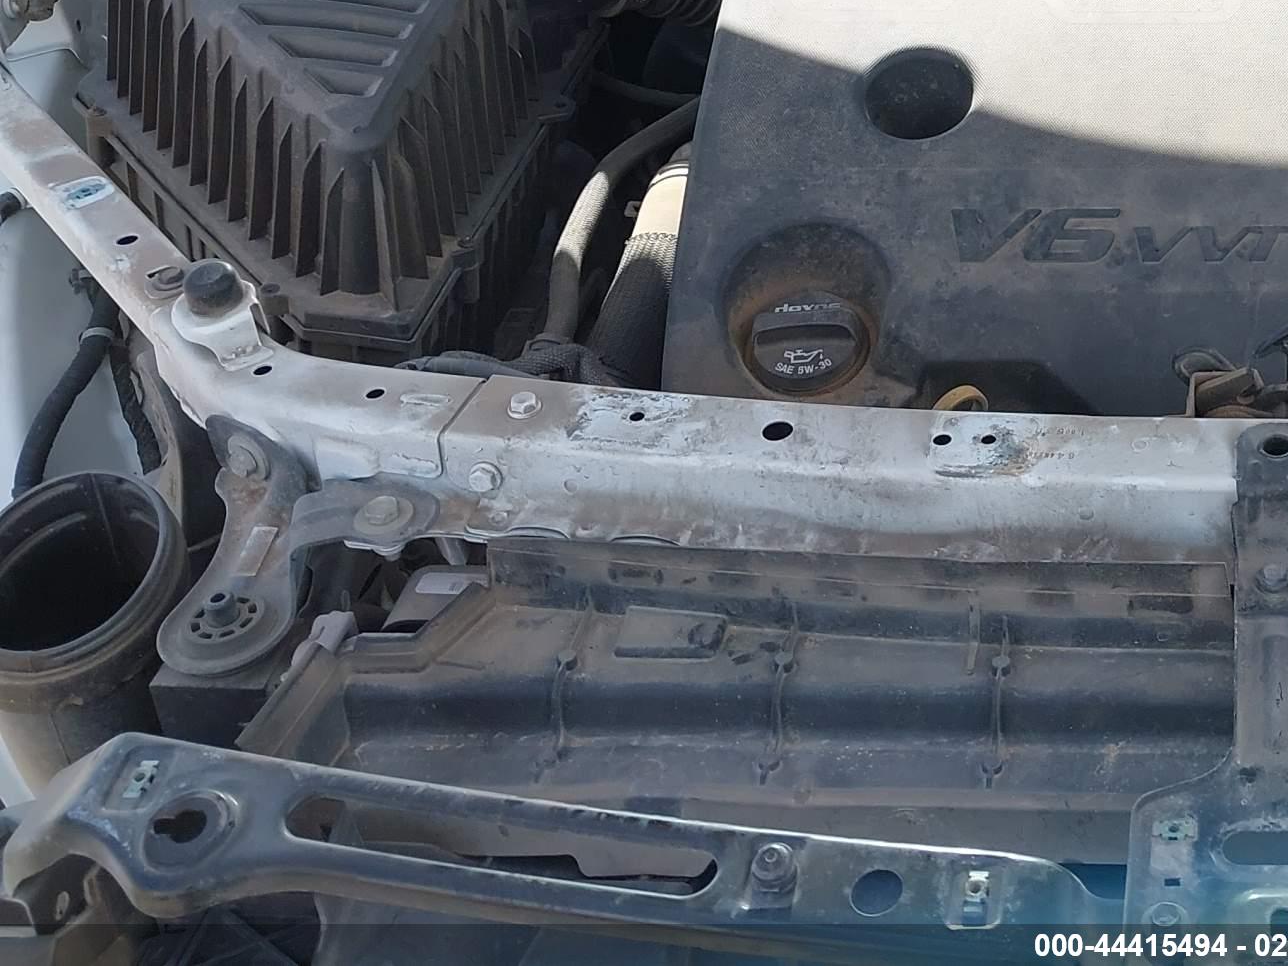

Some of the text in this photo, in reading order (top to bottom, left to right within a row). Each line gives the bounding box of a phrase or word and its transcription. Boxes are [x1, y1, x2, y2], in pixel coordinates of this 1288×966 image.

[951, 207, 1121, 264] V6
[774, 358, 833, 375] SAE 5W-30
